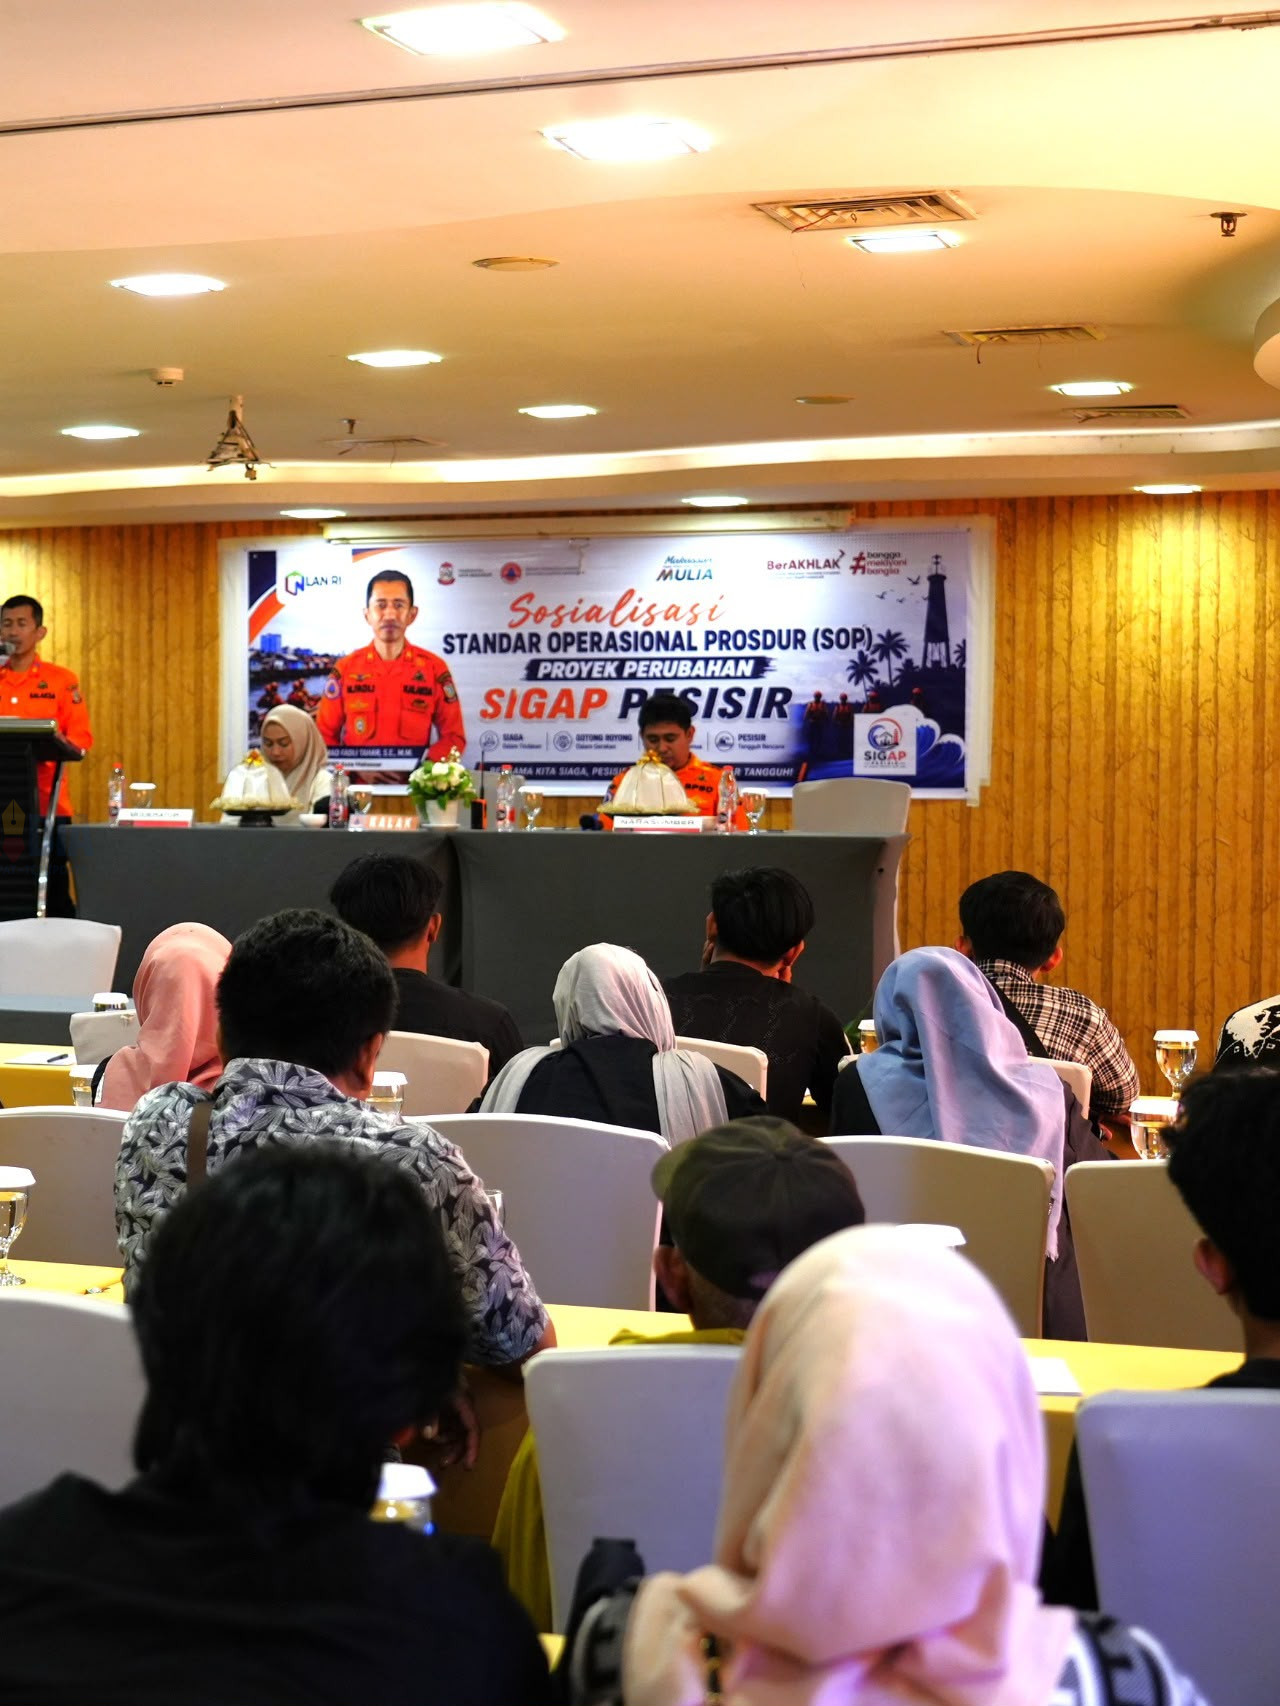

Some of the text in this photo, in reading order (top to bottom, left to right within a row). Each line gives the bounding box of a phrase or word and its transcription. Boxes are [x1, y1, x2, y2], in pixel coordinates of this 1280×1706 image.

[767, 557, 841, 571] BerAKHLAK
[656, 566, 713, 582] MULIA
[305, 575, 342, 587] LAN RI
[508, 588, 726, 629] Sosialisasi
[443, 627, 873, 654] STANDAR OPERASIONAL PROSDUR (SOP)
[537, 659, 755, 679] PROYEK PERUBAHAN
[479, 687, 608, 720] SIGAP
[575, 733, 604, 742] GOTONG
[738, 733, 766, 742] PESISIR
[864, 750, 907, 761] SIGAP
[536, 766, 556, 776] KITA
[592, 767, 625, 777] PESISI
[743, 767, 794, 777] TANGGUH!
[684, 783, 713, 794] BPBD
[369, 816, 413, 829] KALAK
